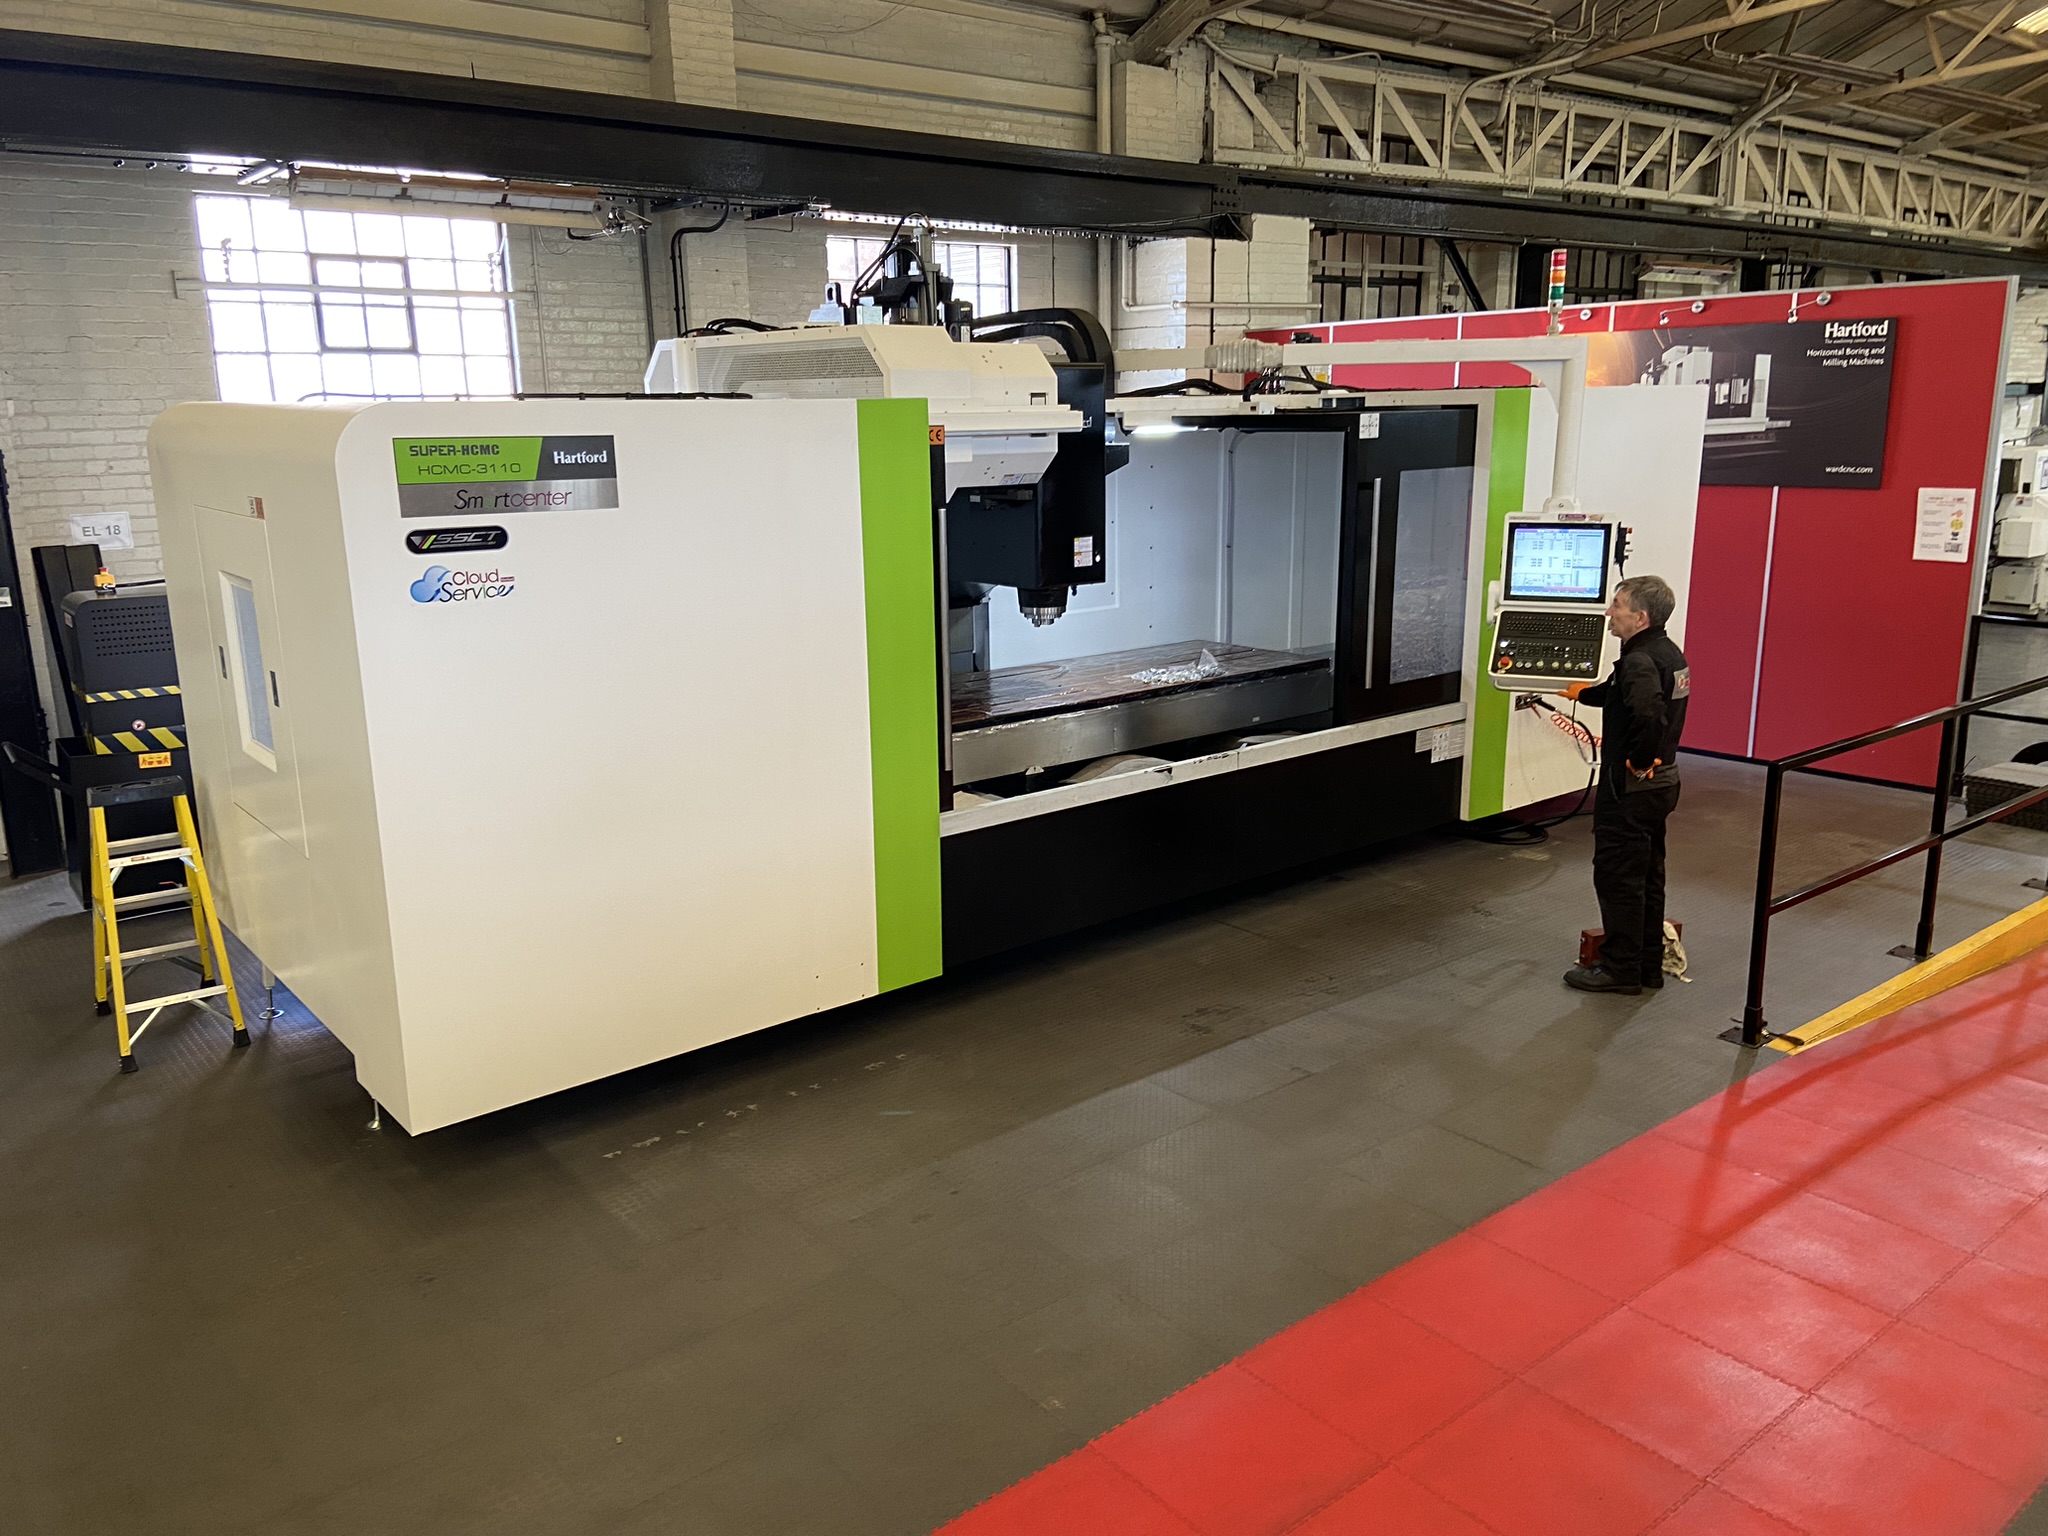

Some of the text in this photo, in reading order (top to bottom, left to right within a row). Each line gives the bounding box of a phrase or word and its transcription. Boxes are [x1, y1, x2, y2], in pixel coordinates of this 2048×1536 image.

[1825, 319, 1889, 338] Hartford
[1806, 345, 1886, 357] Horizontal Boring and
[1822, 357, 1885, 368] Milling Machines
[408, 443, 500, 457] SUPER-HCMC
[552, 449, 608, 465] Hartford
[417, 462, 522, 476] HCMC-3110
[1825, 464, 1874, 474] wardcnc.com
[81, 524, 121, 537] EL 18
[433, 531, 502, 544] SSCT
[452, 568, 500, 586] Cloud
[438, 583, 514, 603] Service
